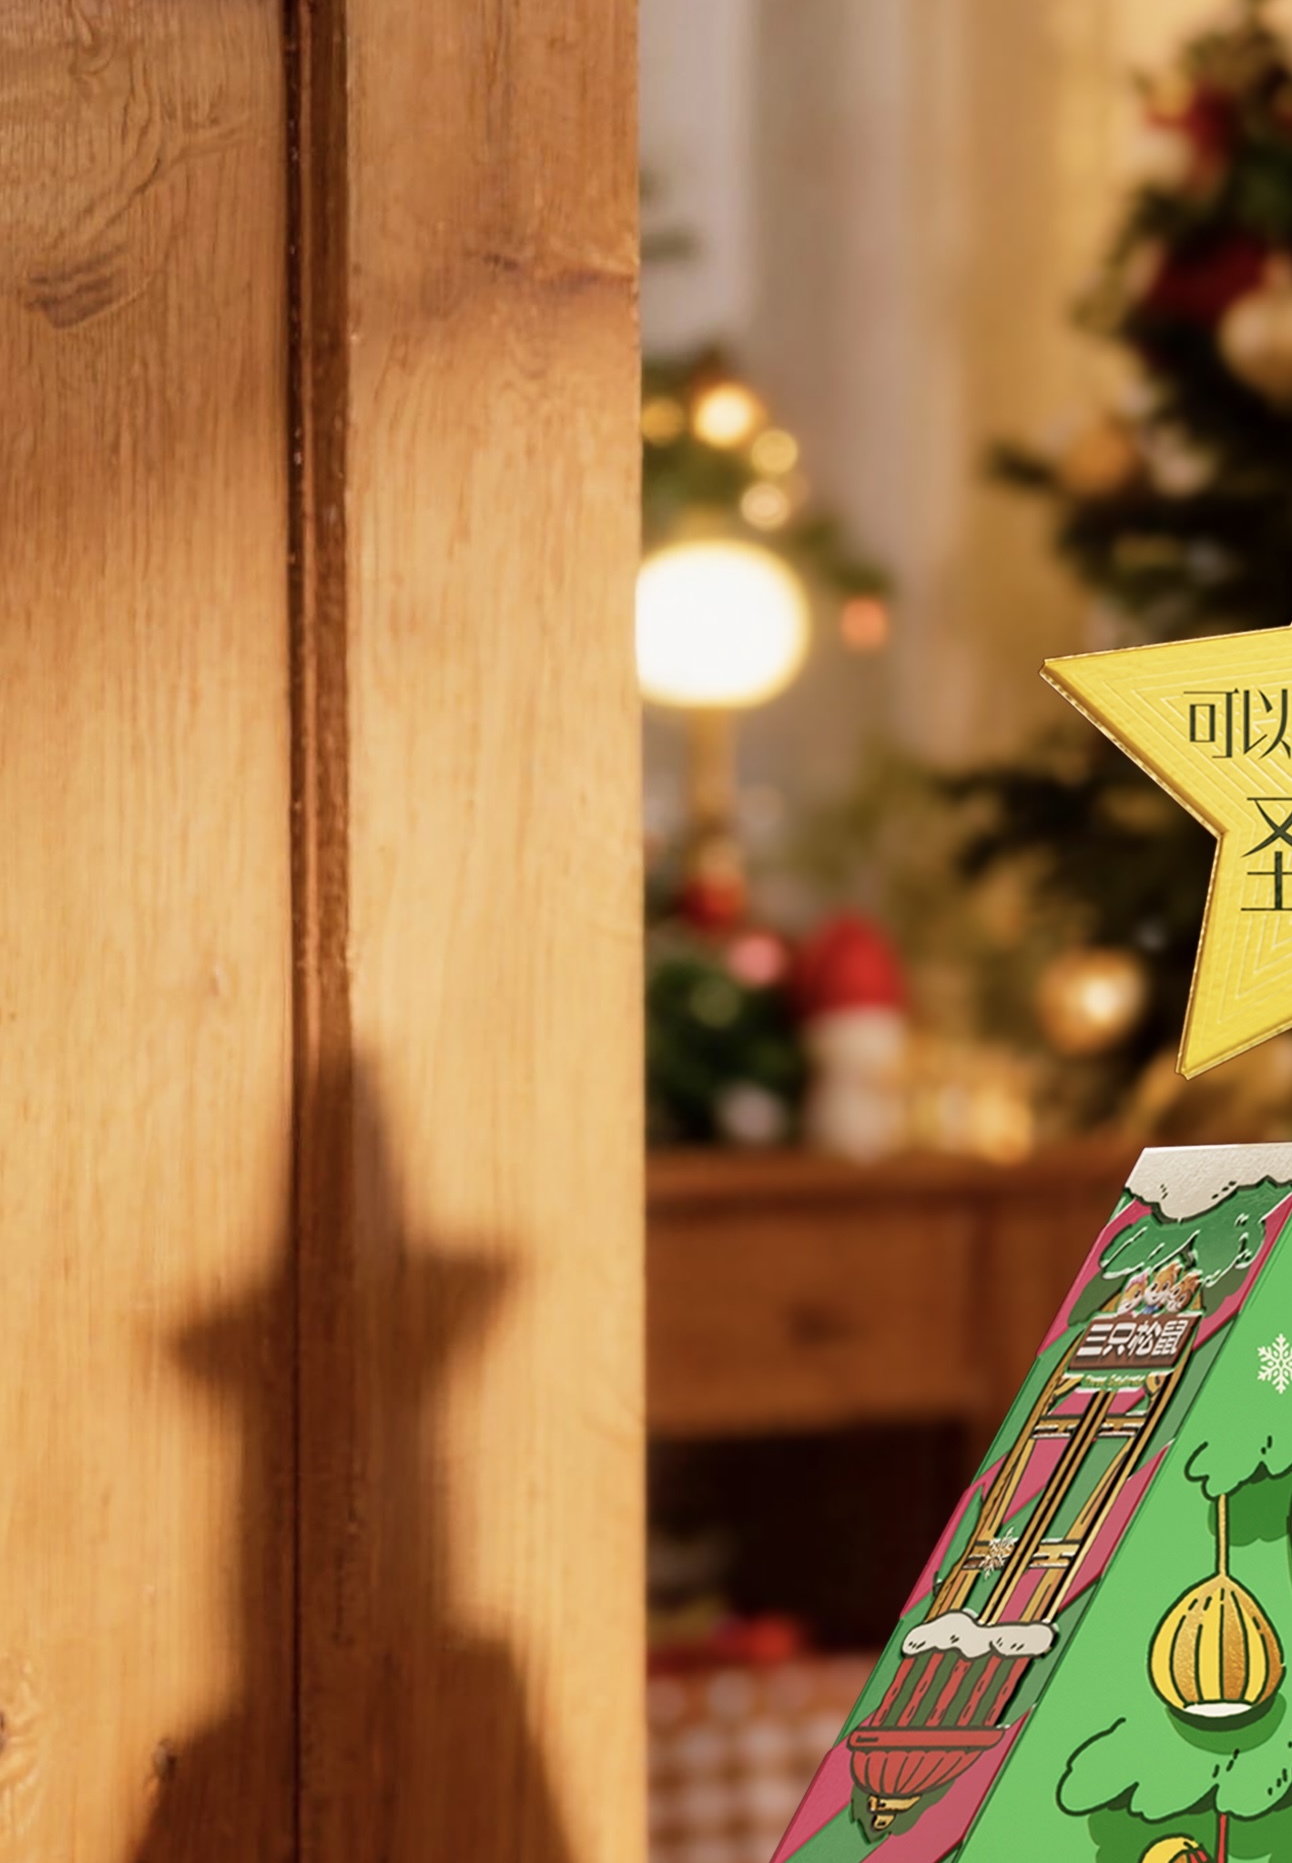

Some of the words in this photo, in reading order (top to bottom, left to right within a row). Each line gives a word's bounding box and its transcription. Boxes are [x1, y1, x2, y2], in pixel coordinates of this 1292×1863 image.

[1183, 688, 1292, 759] 可以
[1077, 1320, 1189, 1357] 三只松鼠
